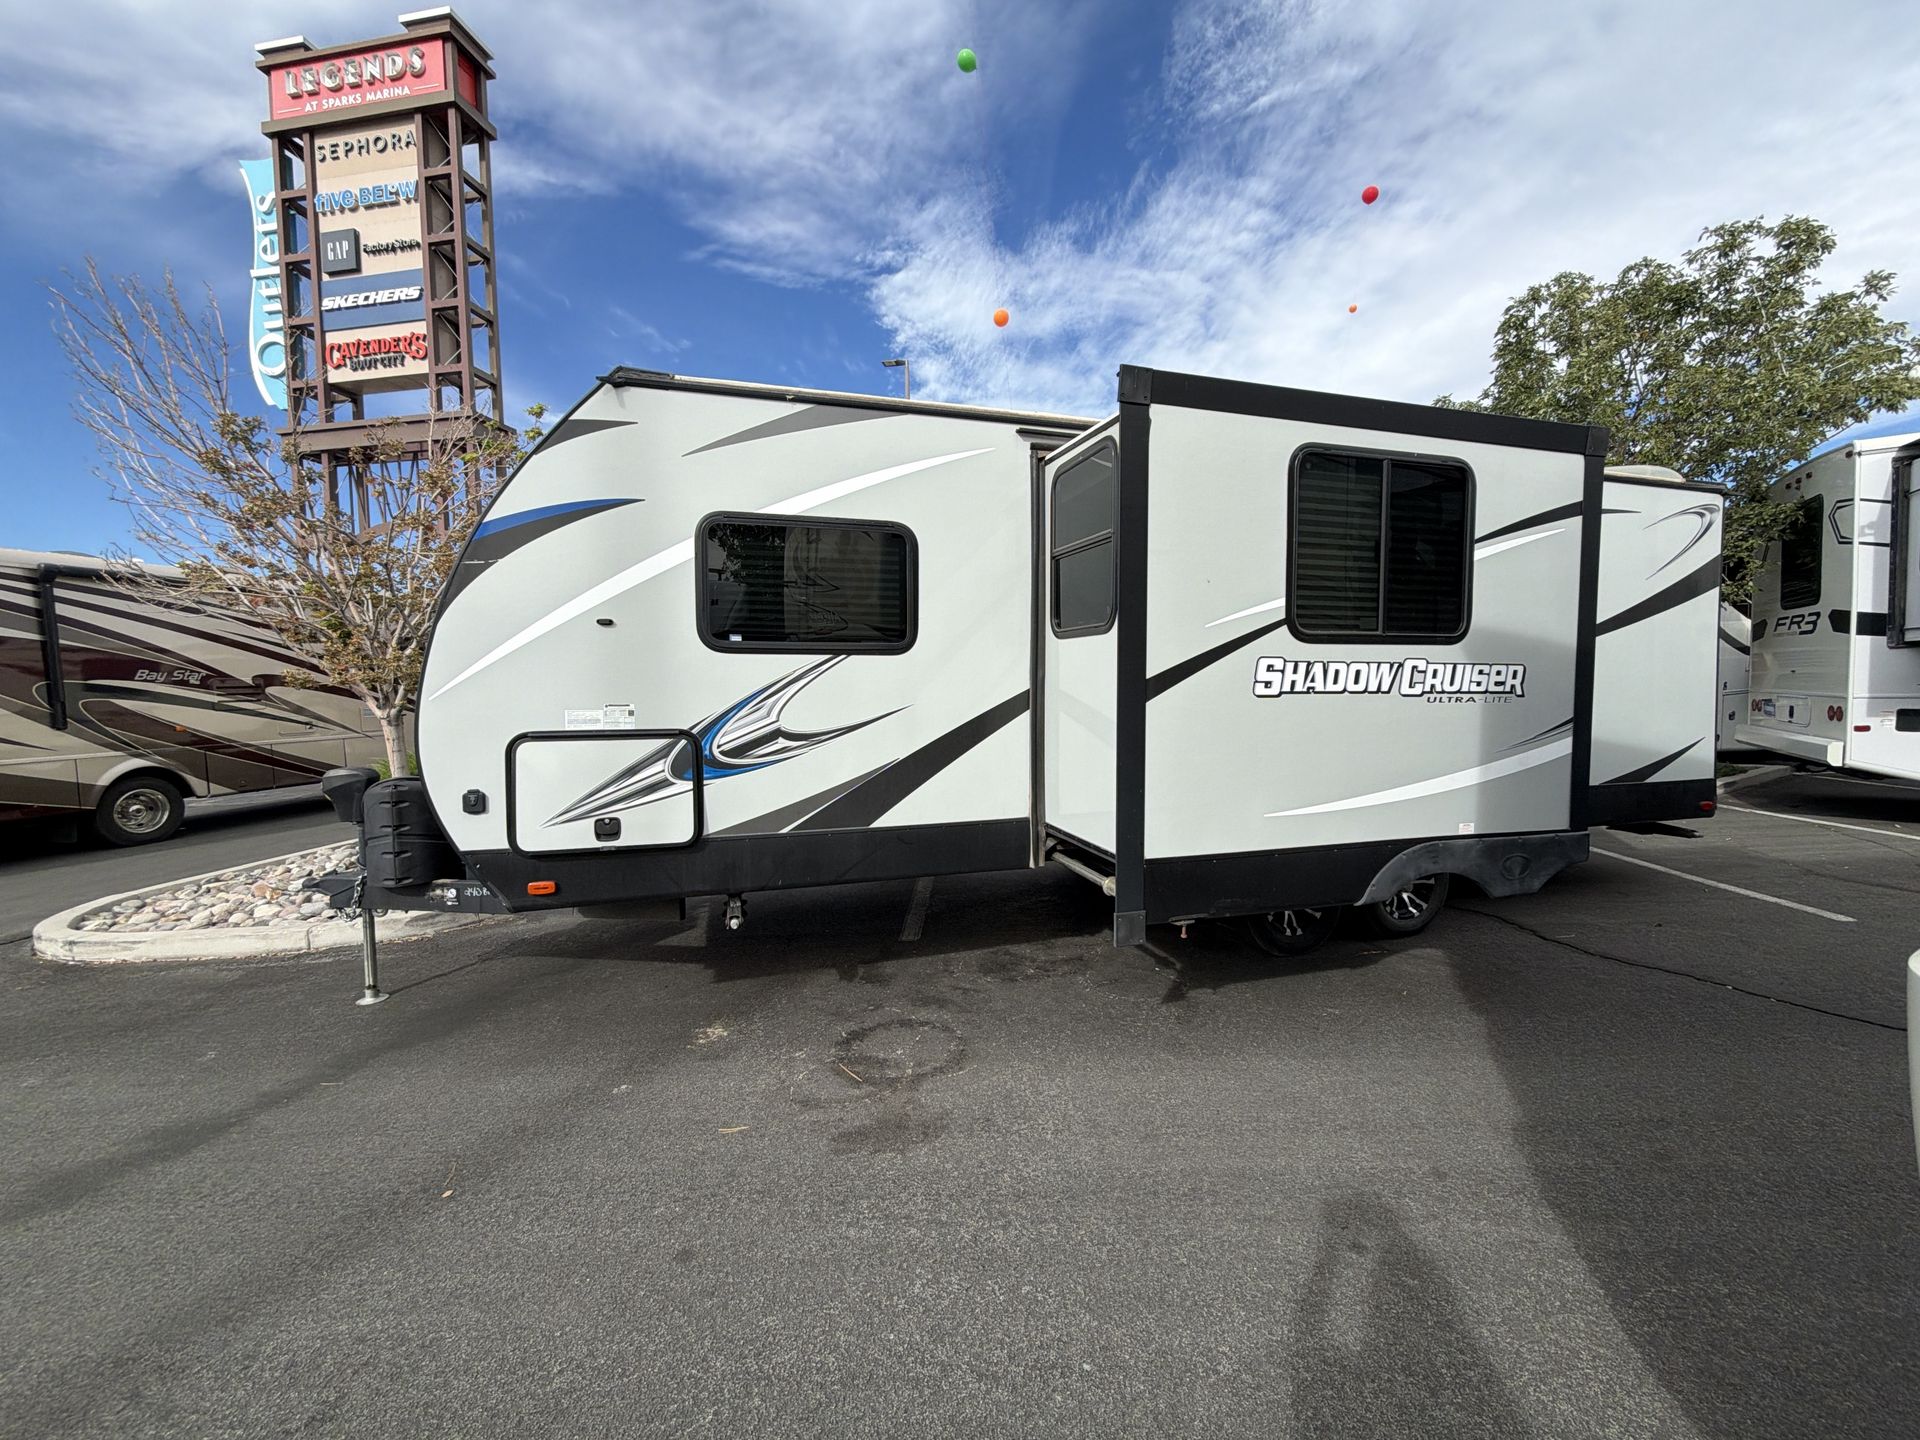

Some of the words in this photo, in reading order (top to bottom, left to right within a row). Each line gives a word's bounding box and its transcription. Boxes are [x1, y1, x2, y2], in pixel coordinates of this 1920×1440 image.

[284, 46, 426, 98] LEGENDS
[304, 101, 318, 112] AT
[322, 92, 362, 109] SPARKS
[366, 86, 411, 102] MARINA
[316, 130, 416, 162] SEPHORA
[358, 179, 417, 206] BELOW
[327, 240, 349, 261] GAP
[362, 241, 393, 254] Factory
[393, 238, 419, 249] Store
[321, 285, 422, 311] SKECHERS
[325, 331, 428, 369] CAVENDER'S
[1773, 611, 1821, 635] FR3
[134, 669, 168, 683] Bay
[171, 669, 207, 682] Star
[1253, 656, 1400, 697] SHADOW
[1426, 696, 1513, 704] ULTRA-LITE
